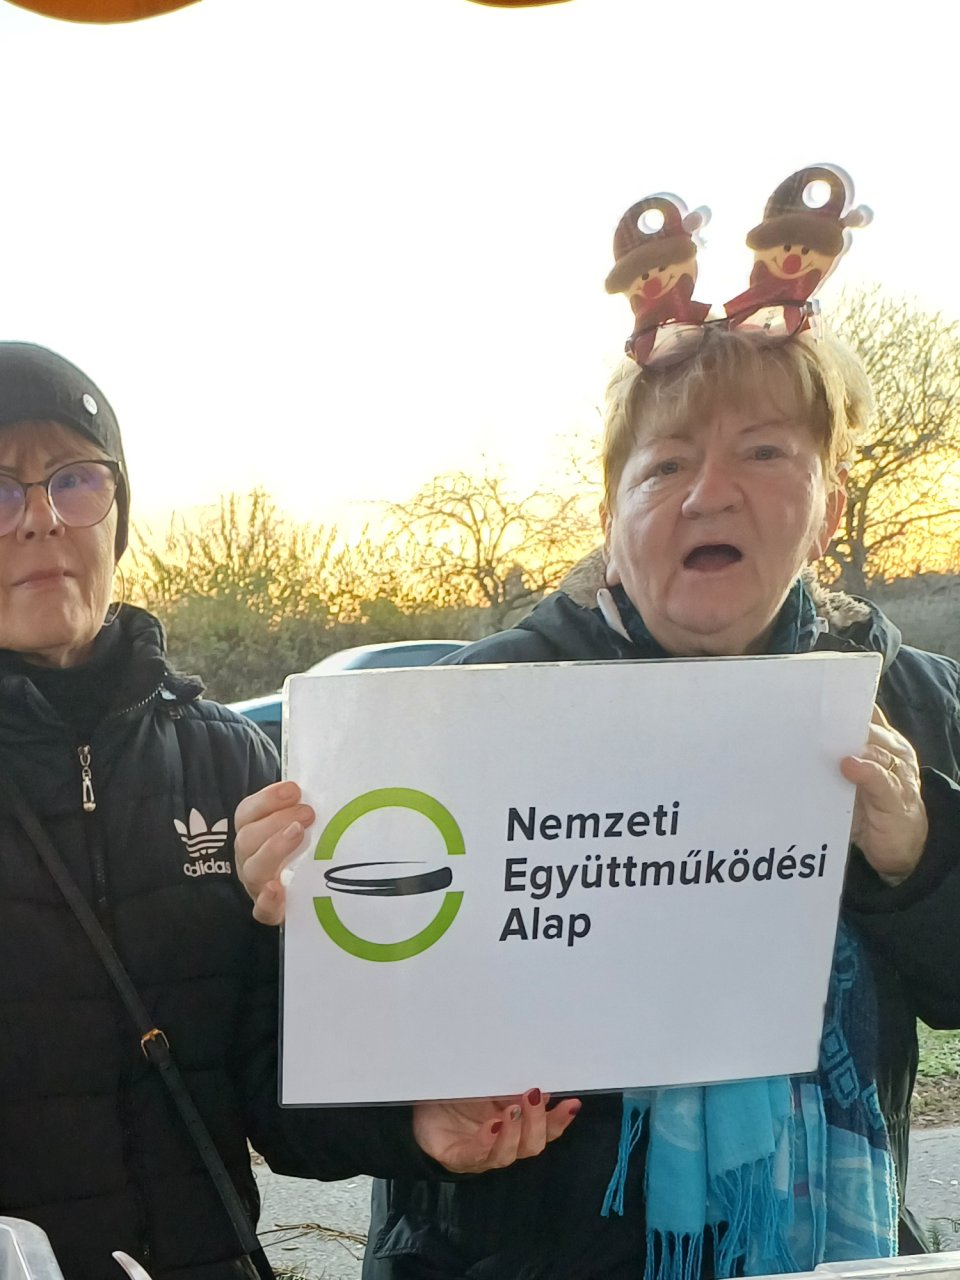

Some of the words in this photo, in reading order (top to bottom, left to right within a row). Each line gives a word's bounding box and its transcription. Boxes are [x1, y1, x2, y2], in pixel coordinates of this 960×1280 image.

[506, 801, 680, 842] Nemzeti
[183, 858, 232, 878] adidas
[503, 844, 828, 900] Együttműködési
[498, 907, 592, 947] Alap
